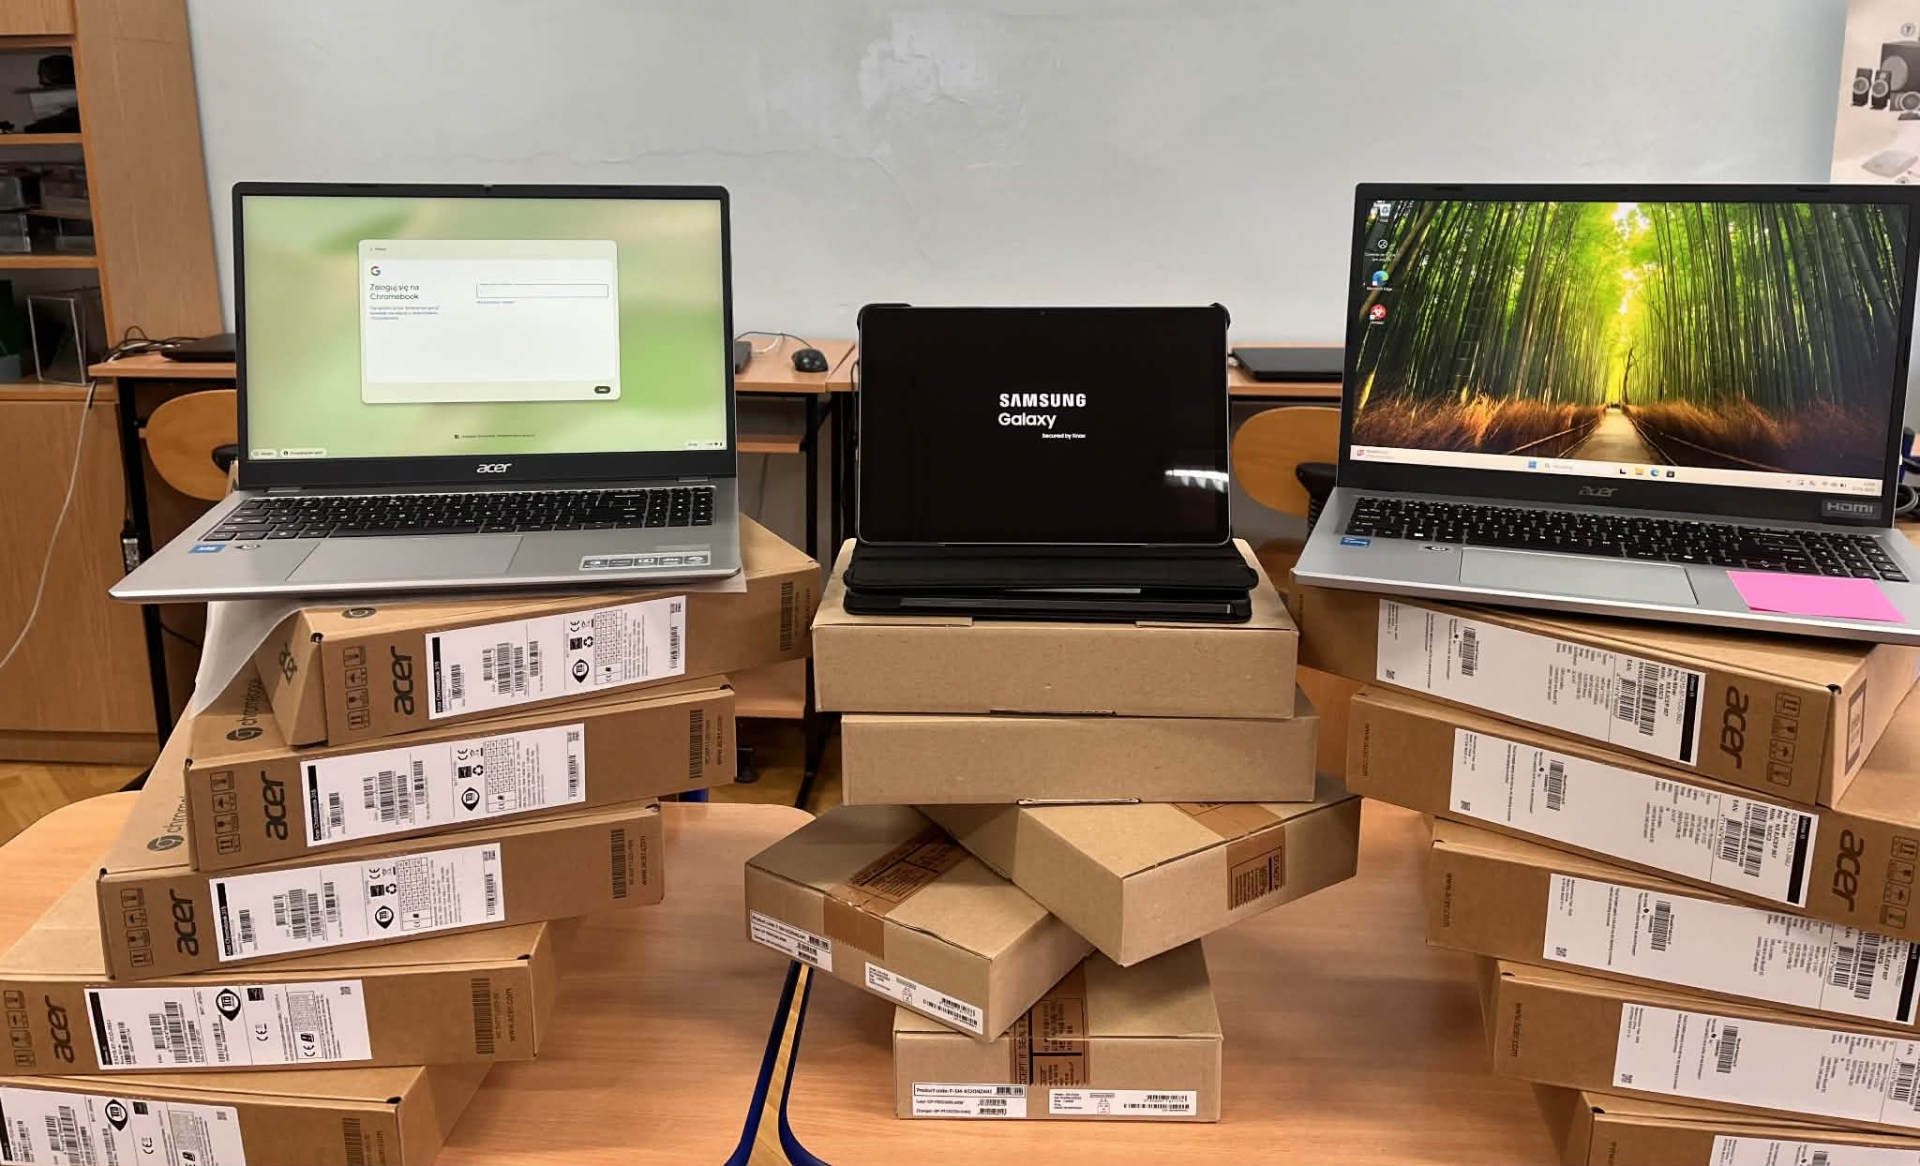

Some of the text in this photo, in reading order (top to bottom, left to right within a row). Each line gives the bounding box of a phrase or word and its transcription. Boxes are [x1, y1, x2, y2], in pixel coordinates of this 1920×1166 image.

[369, 292, 420, 300] Chromebook
[998, 412, 1057, 430] Galaxy
[999, 393, 1087, 408] SAMSUNG
[476, 461, 513, 475] acer
[1577, 485, 1620, 498] acer
[389, 645, 415, 717] acer
[1719, 684, 1750, 770] acer
[260, 770, 289, 841] acer
[1831, 829, 1865, 912] acer
[168, 887, 199, 957] acer
[44, 994, 75, 1064] acer
